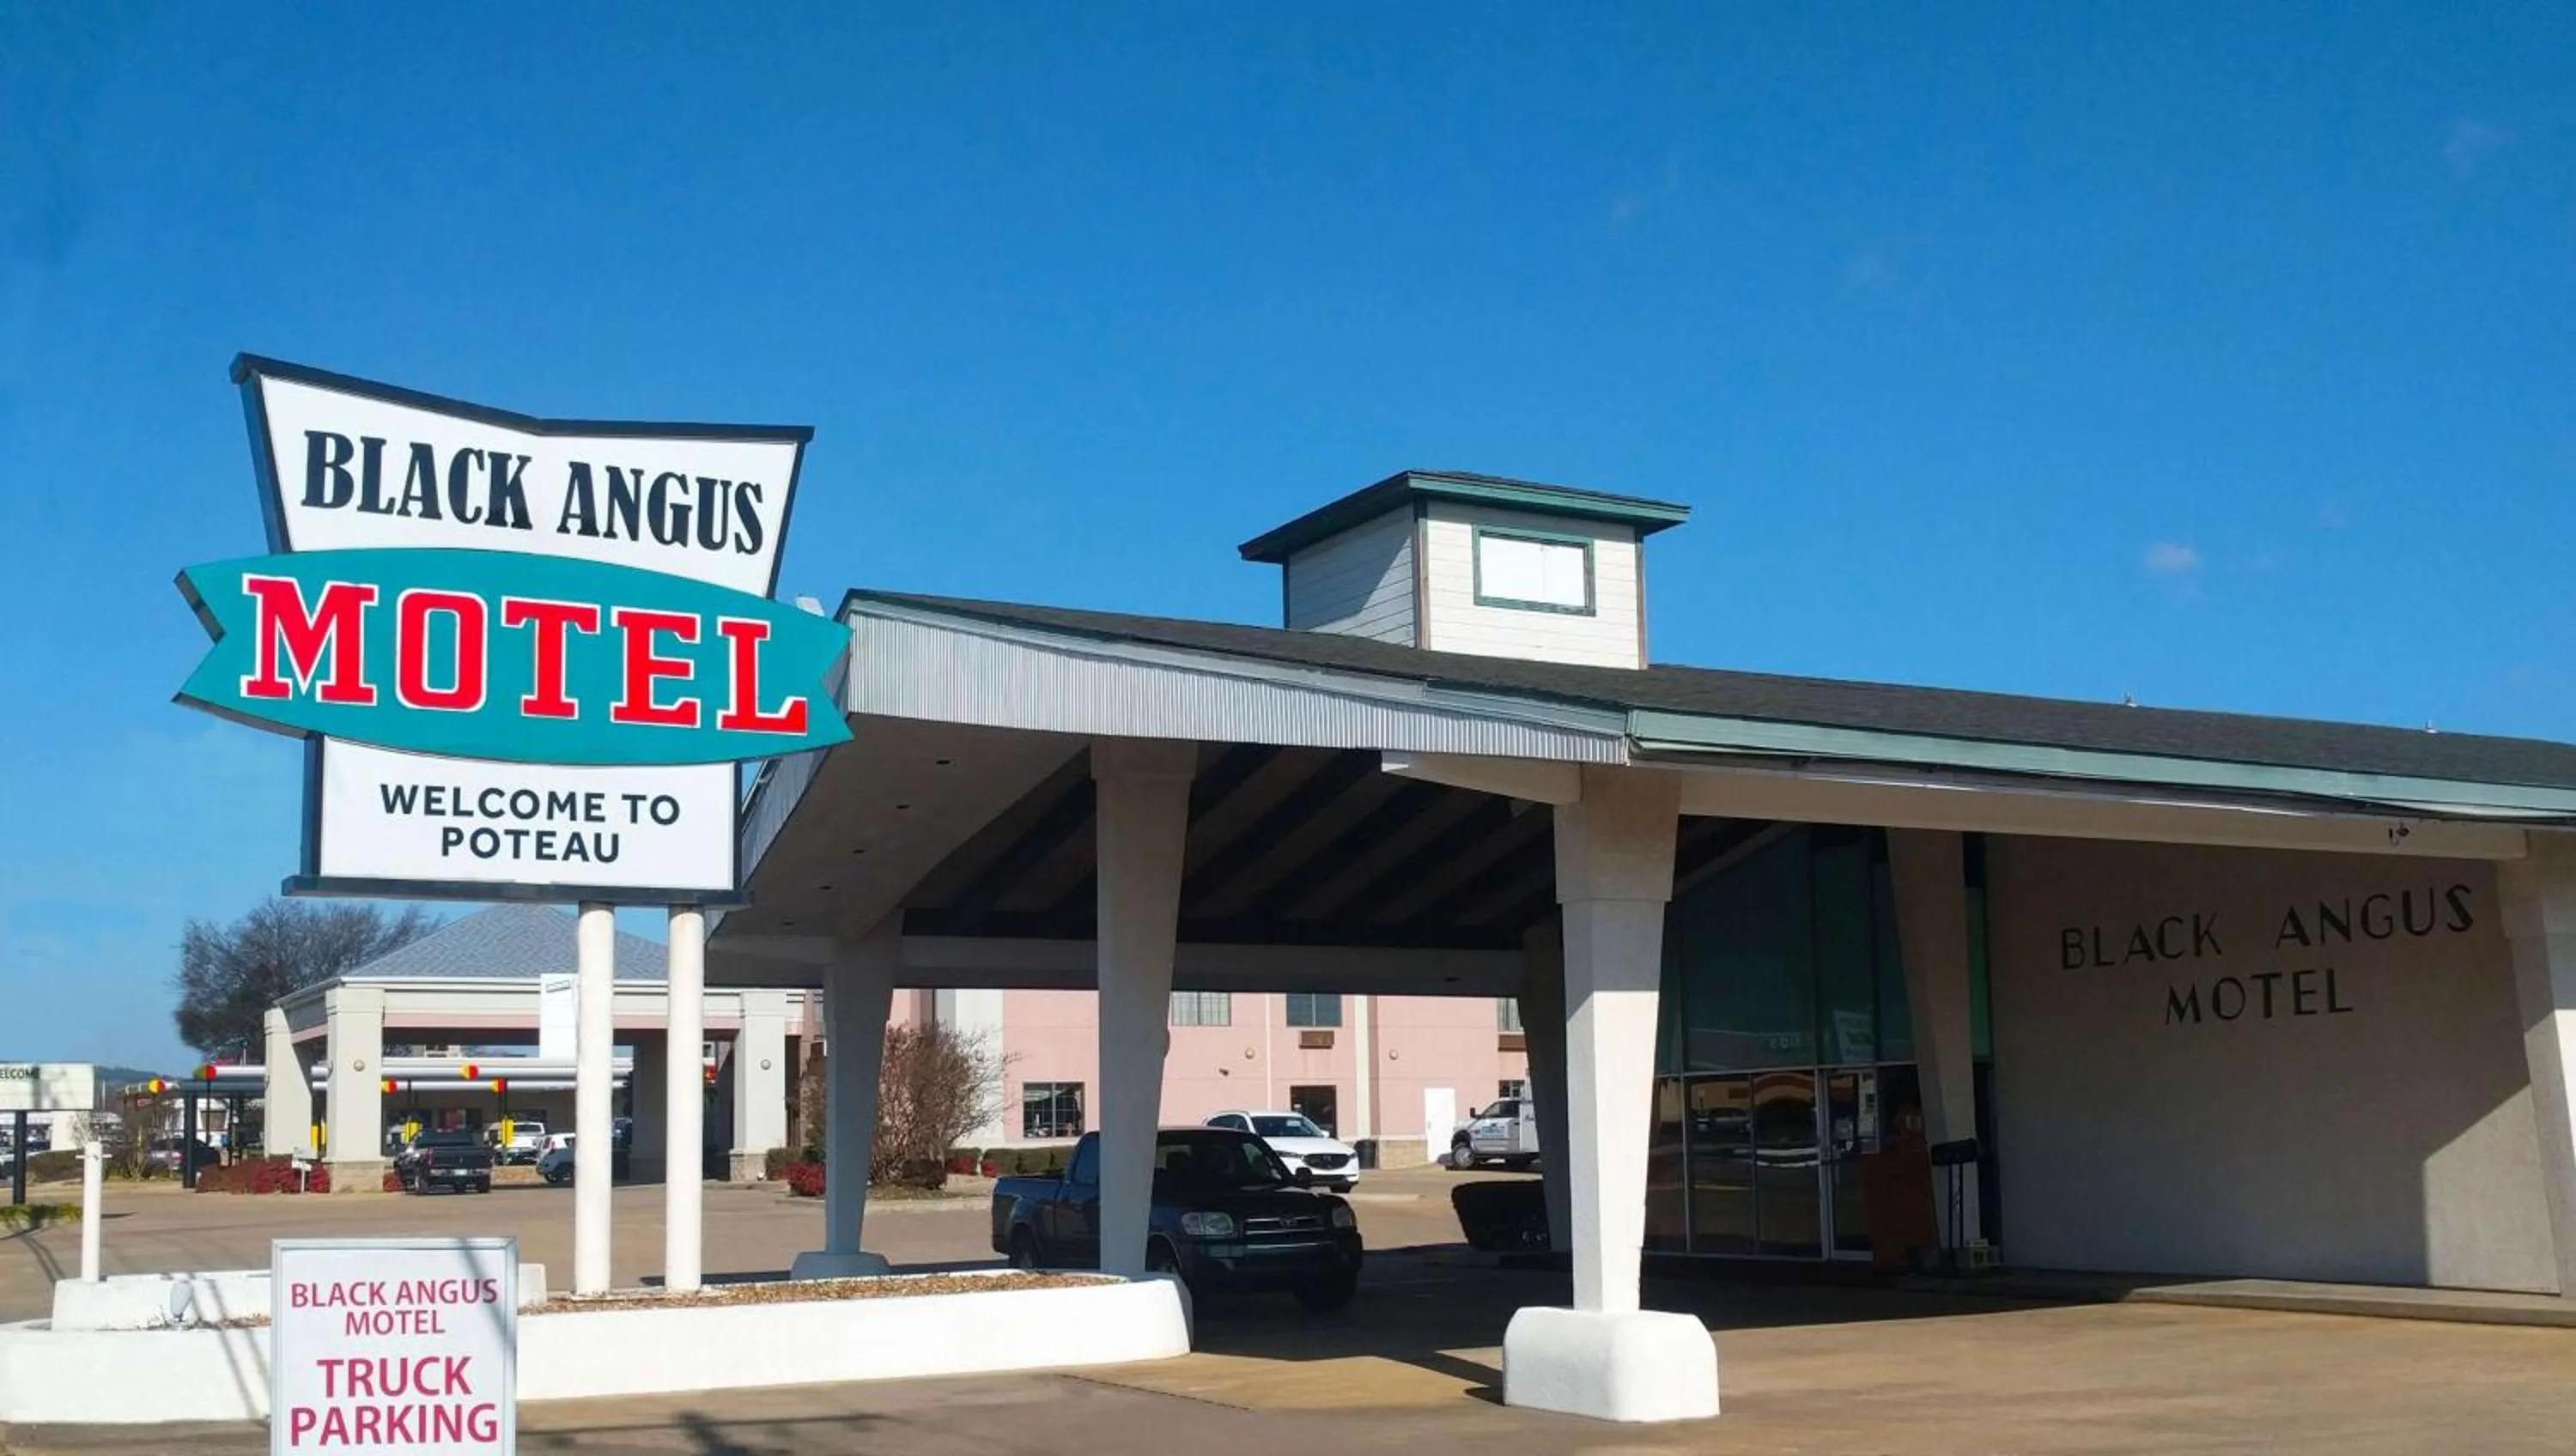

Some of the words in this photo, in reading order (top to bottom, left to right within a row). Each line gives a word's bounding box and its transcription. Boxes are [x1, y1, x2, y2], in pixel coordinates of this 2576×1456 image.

[301, 429, 533, 531] BLACK
[556, 461, 764, 555] ANGUS
[242, 573, 808, 736] MOTEL
[380, 784, 606, 824] WELCOME
[621, 794, 681, 827] TO
[441, 827, 620, 864] POTEAU
[2062, 913, 2222, 971] BLACK
[2275, 883, 2474, 949] ANGUS
[2166, 968, 2354, 1025] MOTEL
[0, 1067, 40, 1079] ELCOM
[291, 1282, 387, 1308] BLACK
[394, 1277, 498, 1306] ANGUS
[345, 1309, 446, 1336] MOTEL
[317, 1356, 472, 1398] TRUCK
[290, 1403, 498, 1447] PARKING
